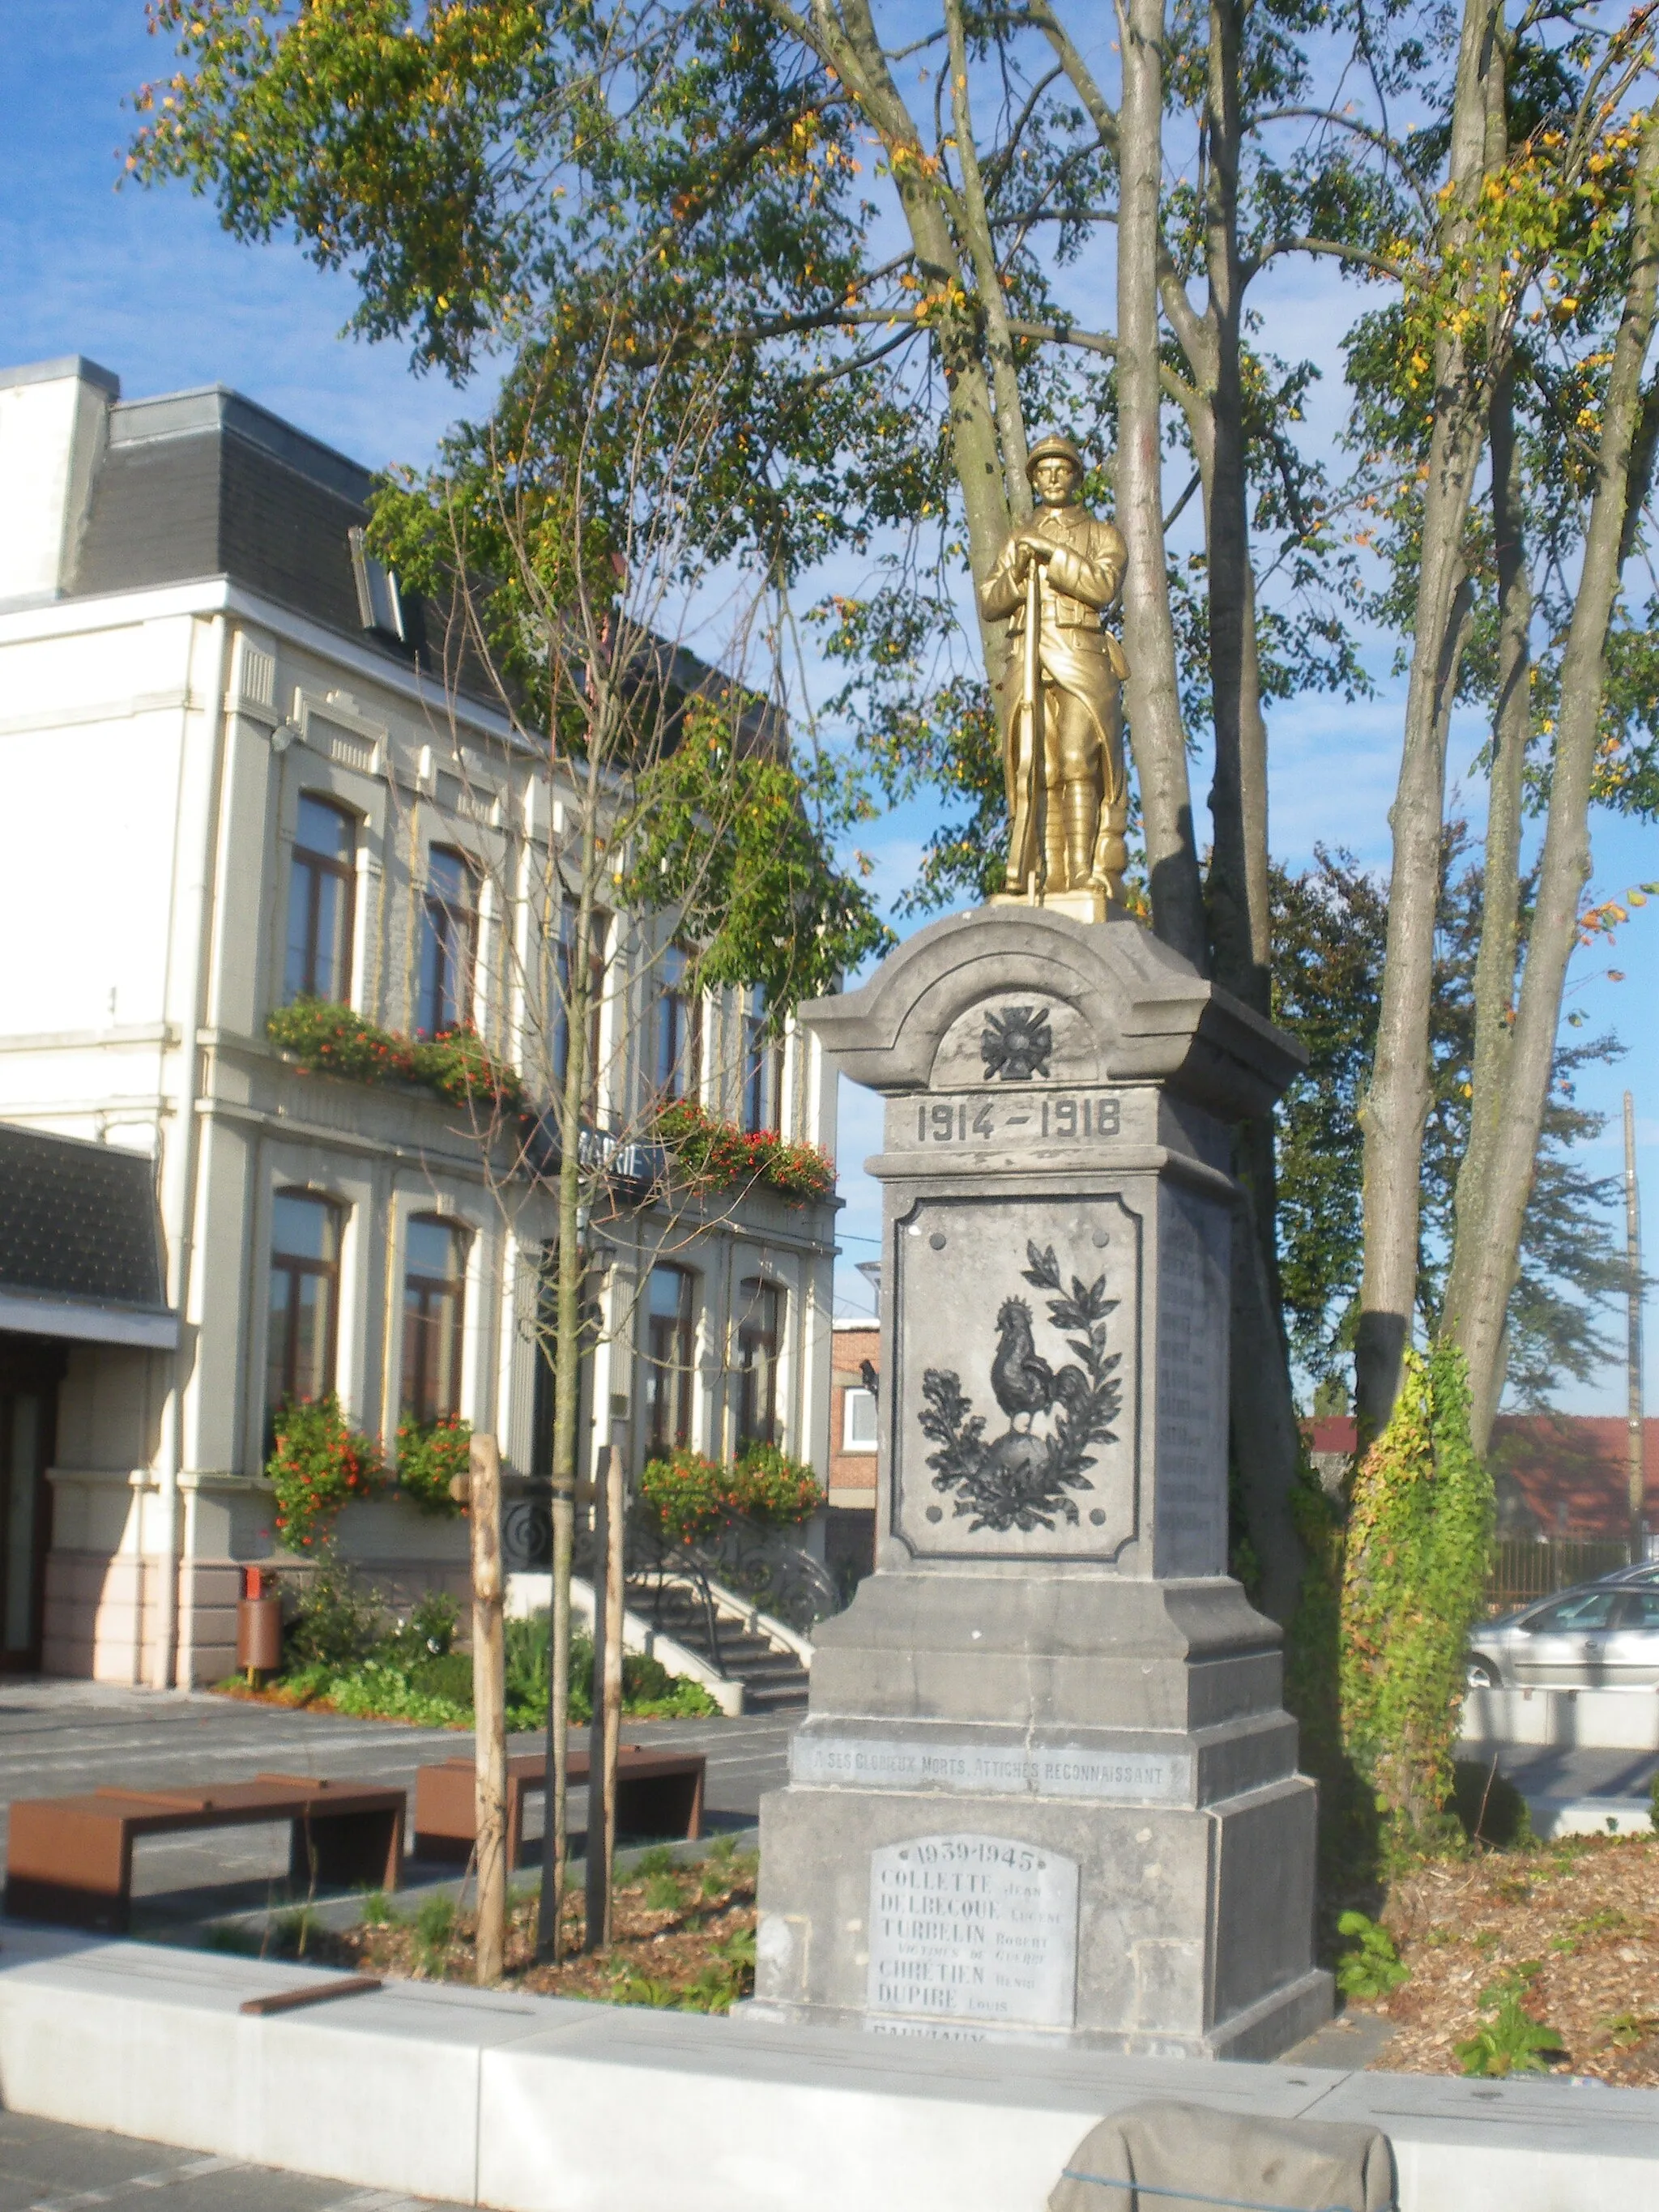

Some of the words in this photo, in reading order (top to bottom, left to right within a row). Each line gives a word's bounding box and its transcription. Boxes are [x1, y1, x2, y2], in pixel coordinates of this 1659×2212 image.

[827, 1753, 851, 1770] SES
[855, 1753, 915, 1773] GLORIEUX
[975, 1758, 1038, 1779] ATTICHES
[1045, 1762, 1163, 1784] RECONNAISSANT
[917, 1843, 1035, 1873] 1939-1945
[881, 1869, 992, 1894] COLLETTE
[881, 1893, 1000, 1922] DELBECQUE
[881, 1917, 985, 1944] TURBELIN
[996, 1931, 1048, 1949] ROBERT
[898, 1943, 959, 1959] VICTIMES
[996, 1950, 1047, 1966] GUERRE
[878, 1984, 957, 2009] DUPIRE
[969, 1997, 1009, 2013] LOUIS
